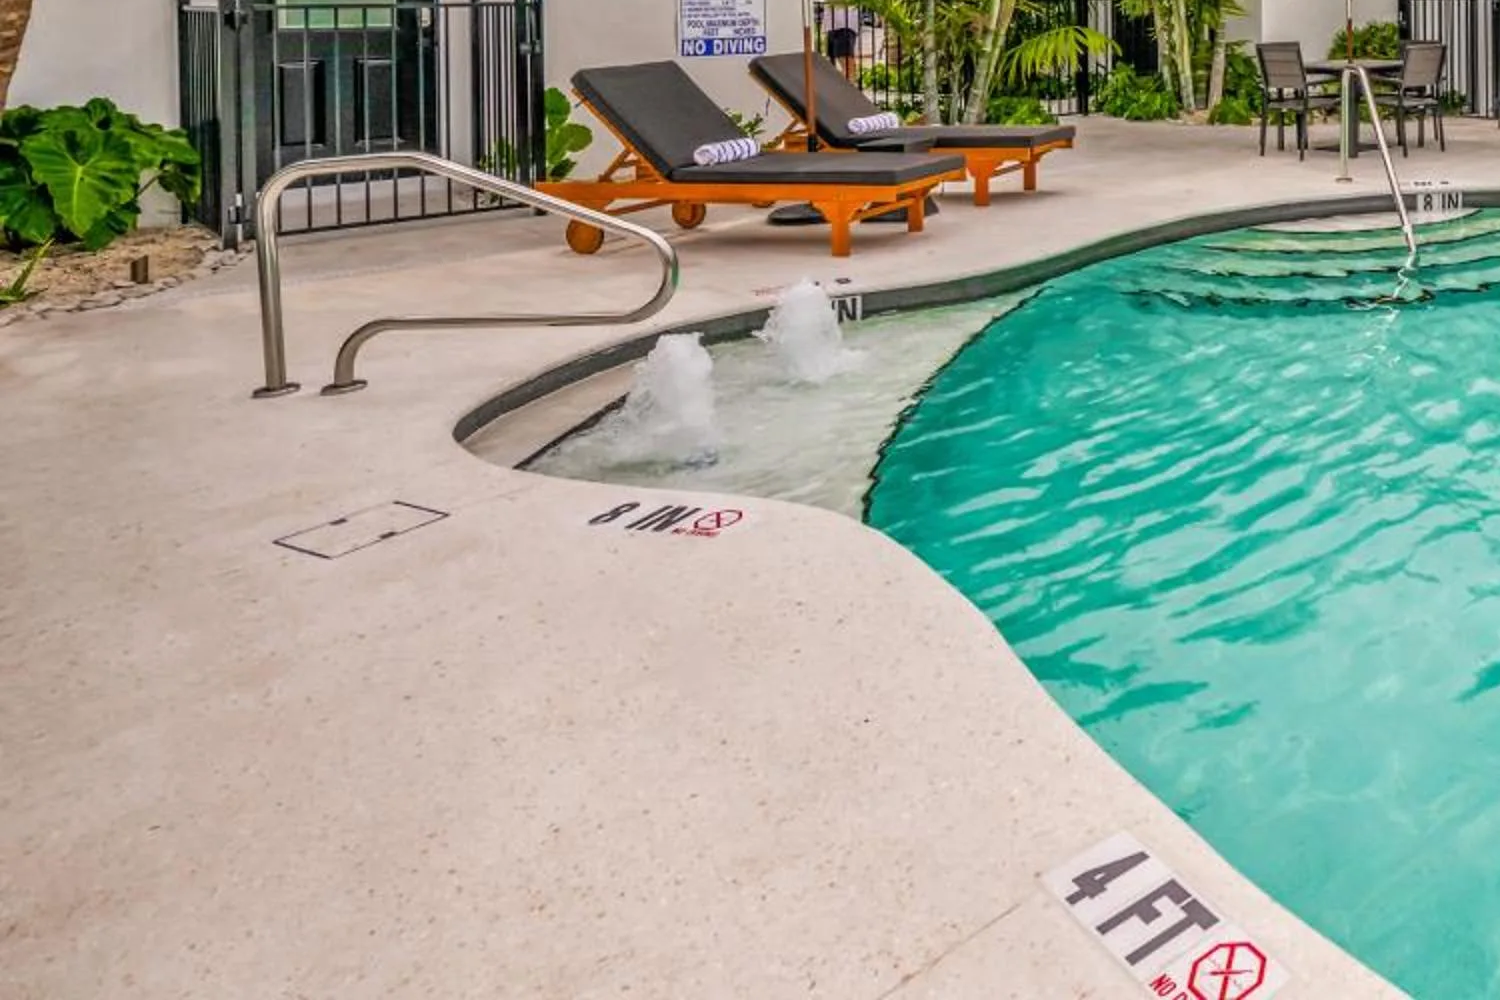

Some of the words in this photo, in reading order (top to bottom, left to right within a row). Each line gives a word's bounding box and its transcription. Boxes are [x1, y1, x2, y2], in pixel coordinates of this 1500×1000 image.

[683, 39, 706, 56] NO
[713, 37, 765, 55] DIVING
[1441, 192, 1459, 210] IN
[588, 502, 641, 526] 8
[624, 505, 702, 532] IN
[1064, 851, 1150, 906] 4
[1095, 878, 1220, 966] FT
[1150, 973, 1177, 997] NO
